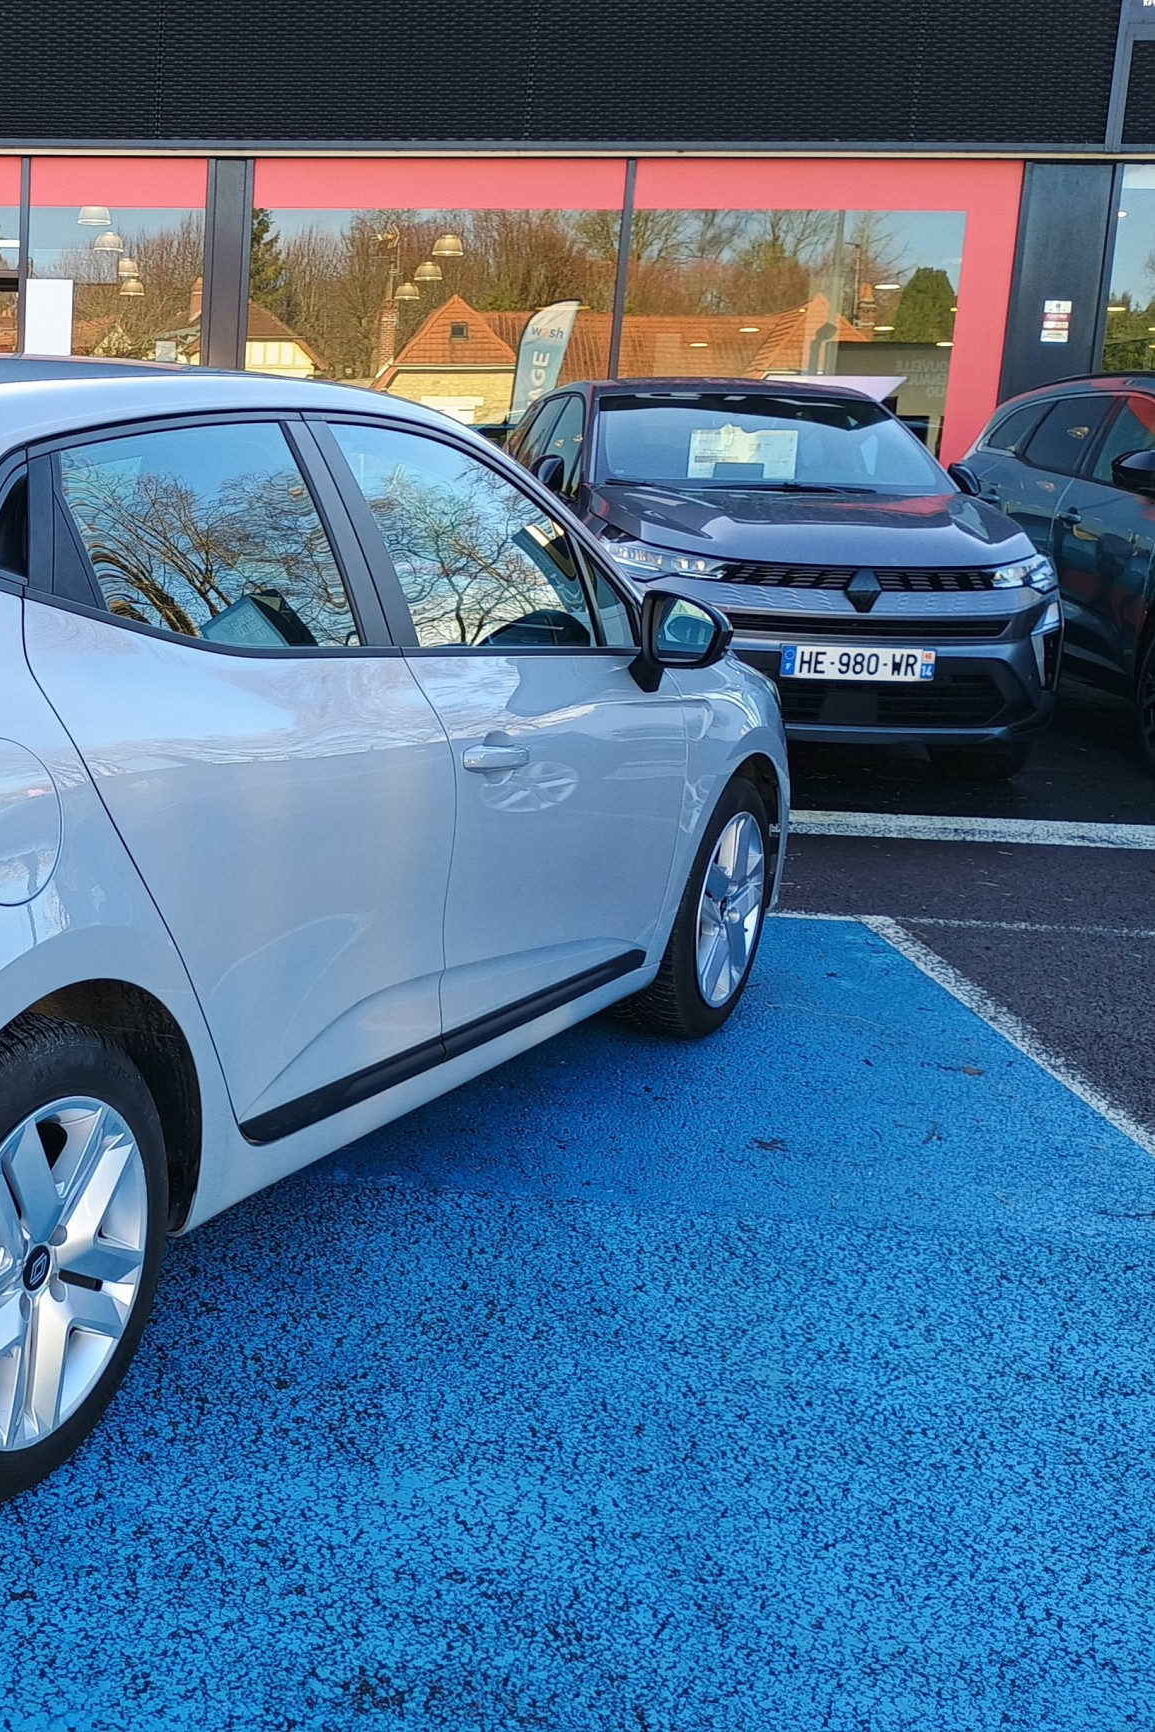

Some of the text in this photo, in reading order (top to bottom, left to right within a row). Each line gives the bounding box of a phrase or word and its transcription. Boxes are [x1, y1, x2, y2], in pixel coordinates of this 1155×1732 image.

[531, 326, 564, 339] wash
[527, 351, 551, 407] AGE
[798, 651, 918, 676] HE-980-WR
[921, 664, 933, 677] 14
